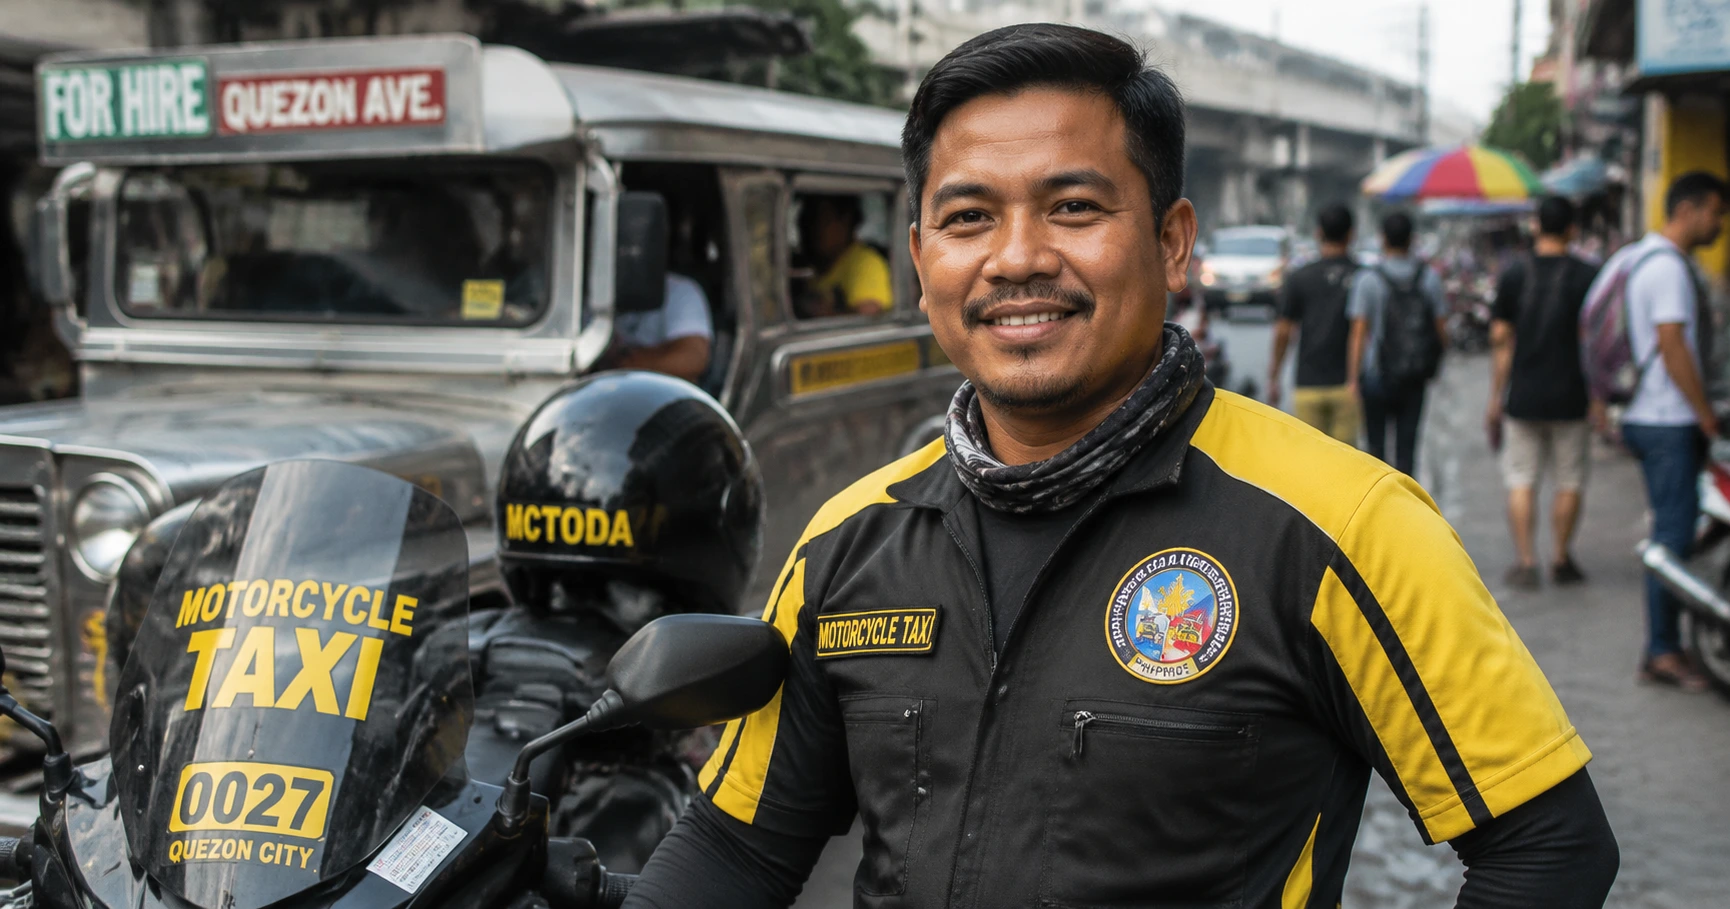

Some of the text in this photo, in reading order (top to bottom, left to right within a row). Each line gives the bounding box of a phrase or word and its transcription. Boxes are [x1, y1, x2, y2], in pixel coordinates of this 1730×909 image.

[45, 64, 208, 140] FOR HIRE
[222, 74, 442, 132] QUEZON AVE.
[507, 503, 634, 547] MCTODA
[175, 578, 419, 637] MOTORCYCLE
[818, 615, 900, 650] MOTORCYCLE
[184, 626, 384, 721] TAXI
[179, 770, 325, 831] 0027
[168, 838, 254, 864] QUEZON
